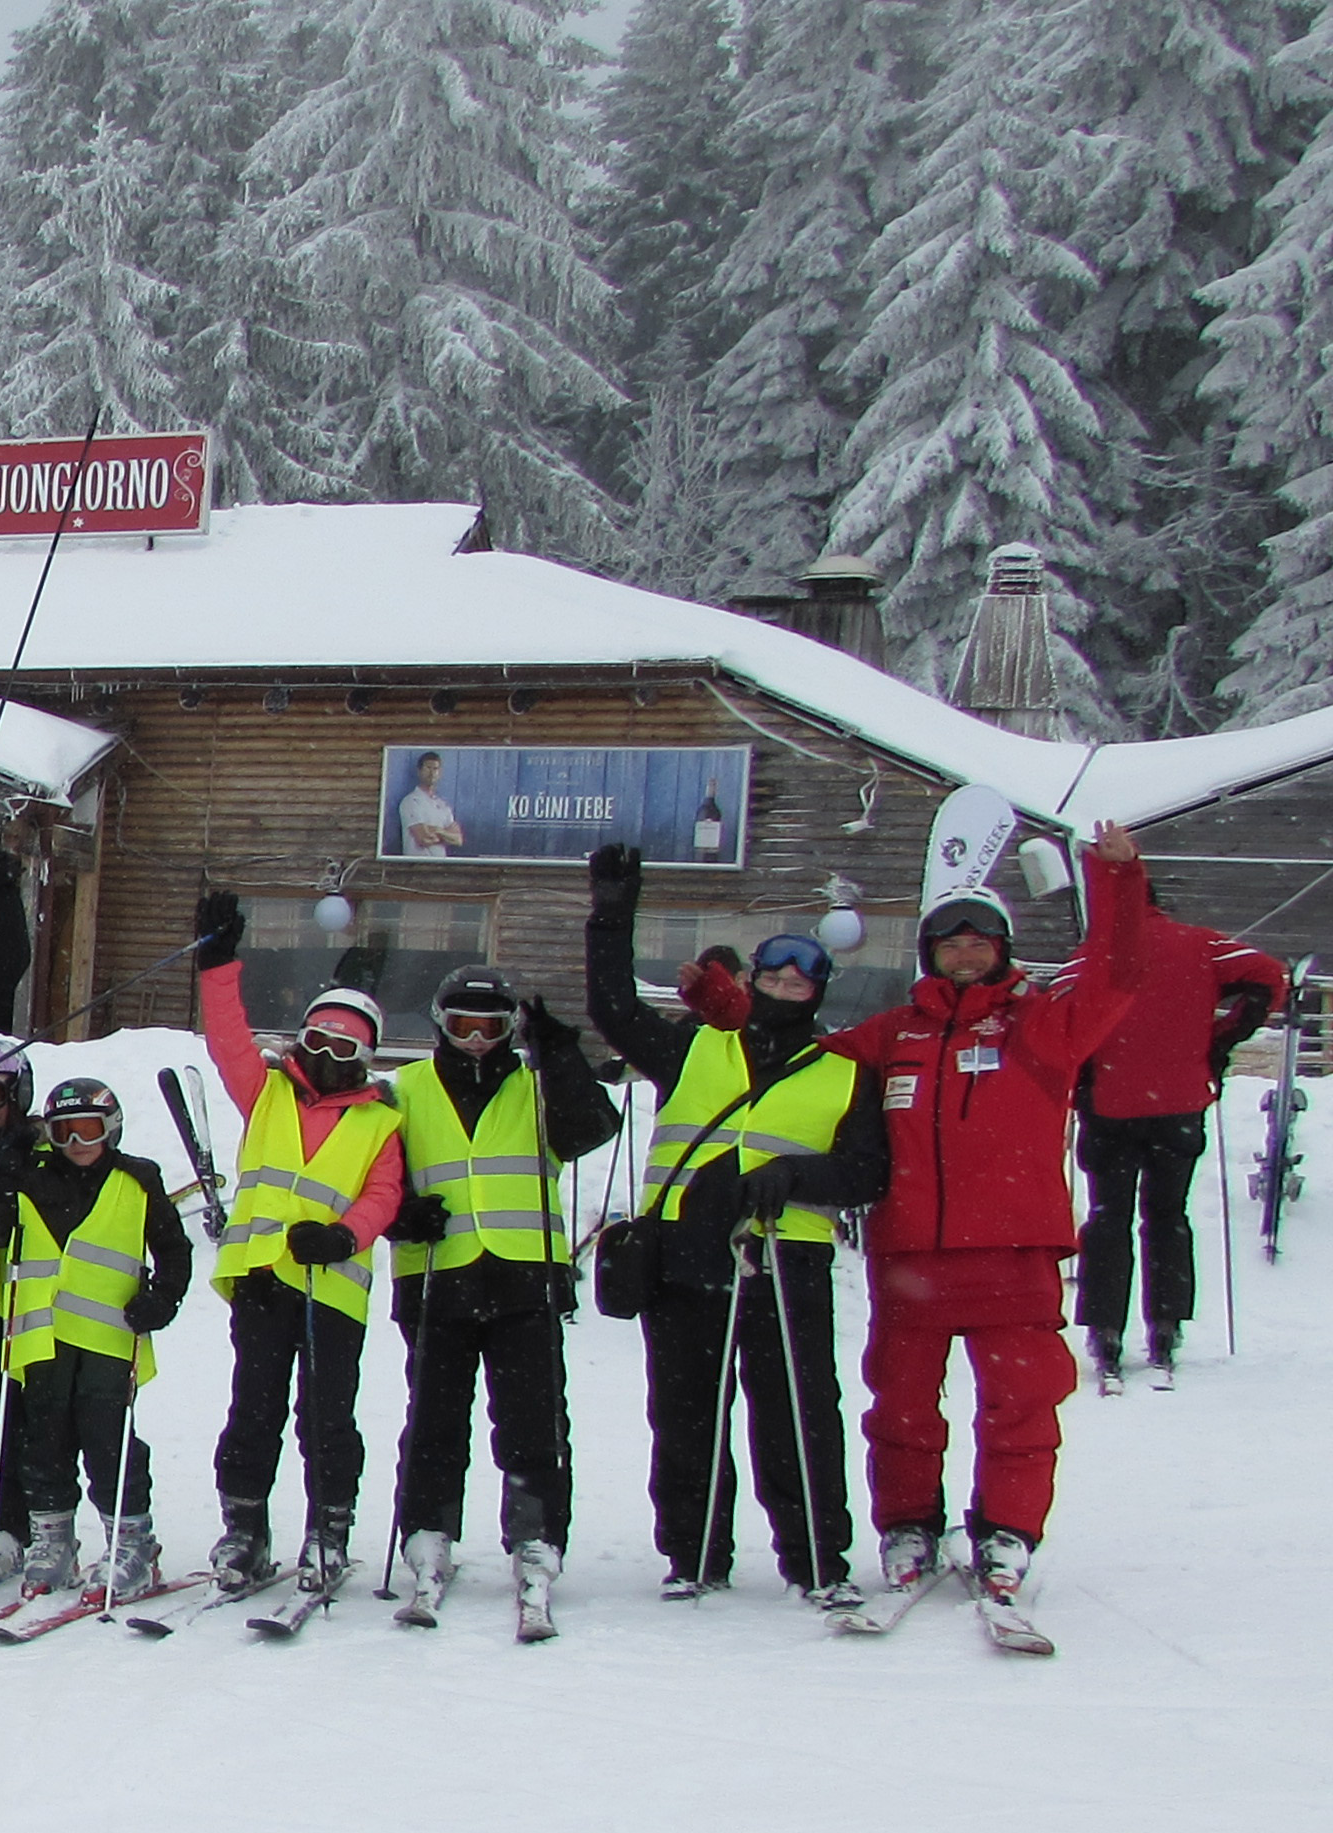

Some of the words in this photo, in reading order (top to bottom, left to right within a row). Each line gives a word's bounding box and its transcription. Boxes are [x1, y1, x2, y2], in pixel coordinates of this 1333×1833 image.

[507, 795, 530, 819] KO
[534, 791, 569, 819] ČINI
[574, 796, 615, 820] TEBE
[977, 819, 1010, 867] CREEK
